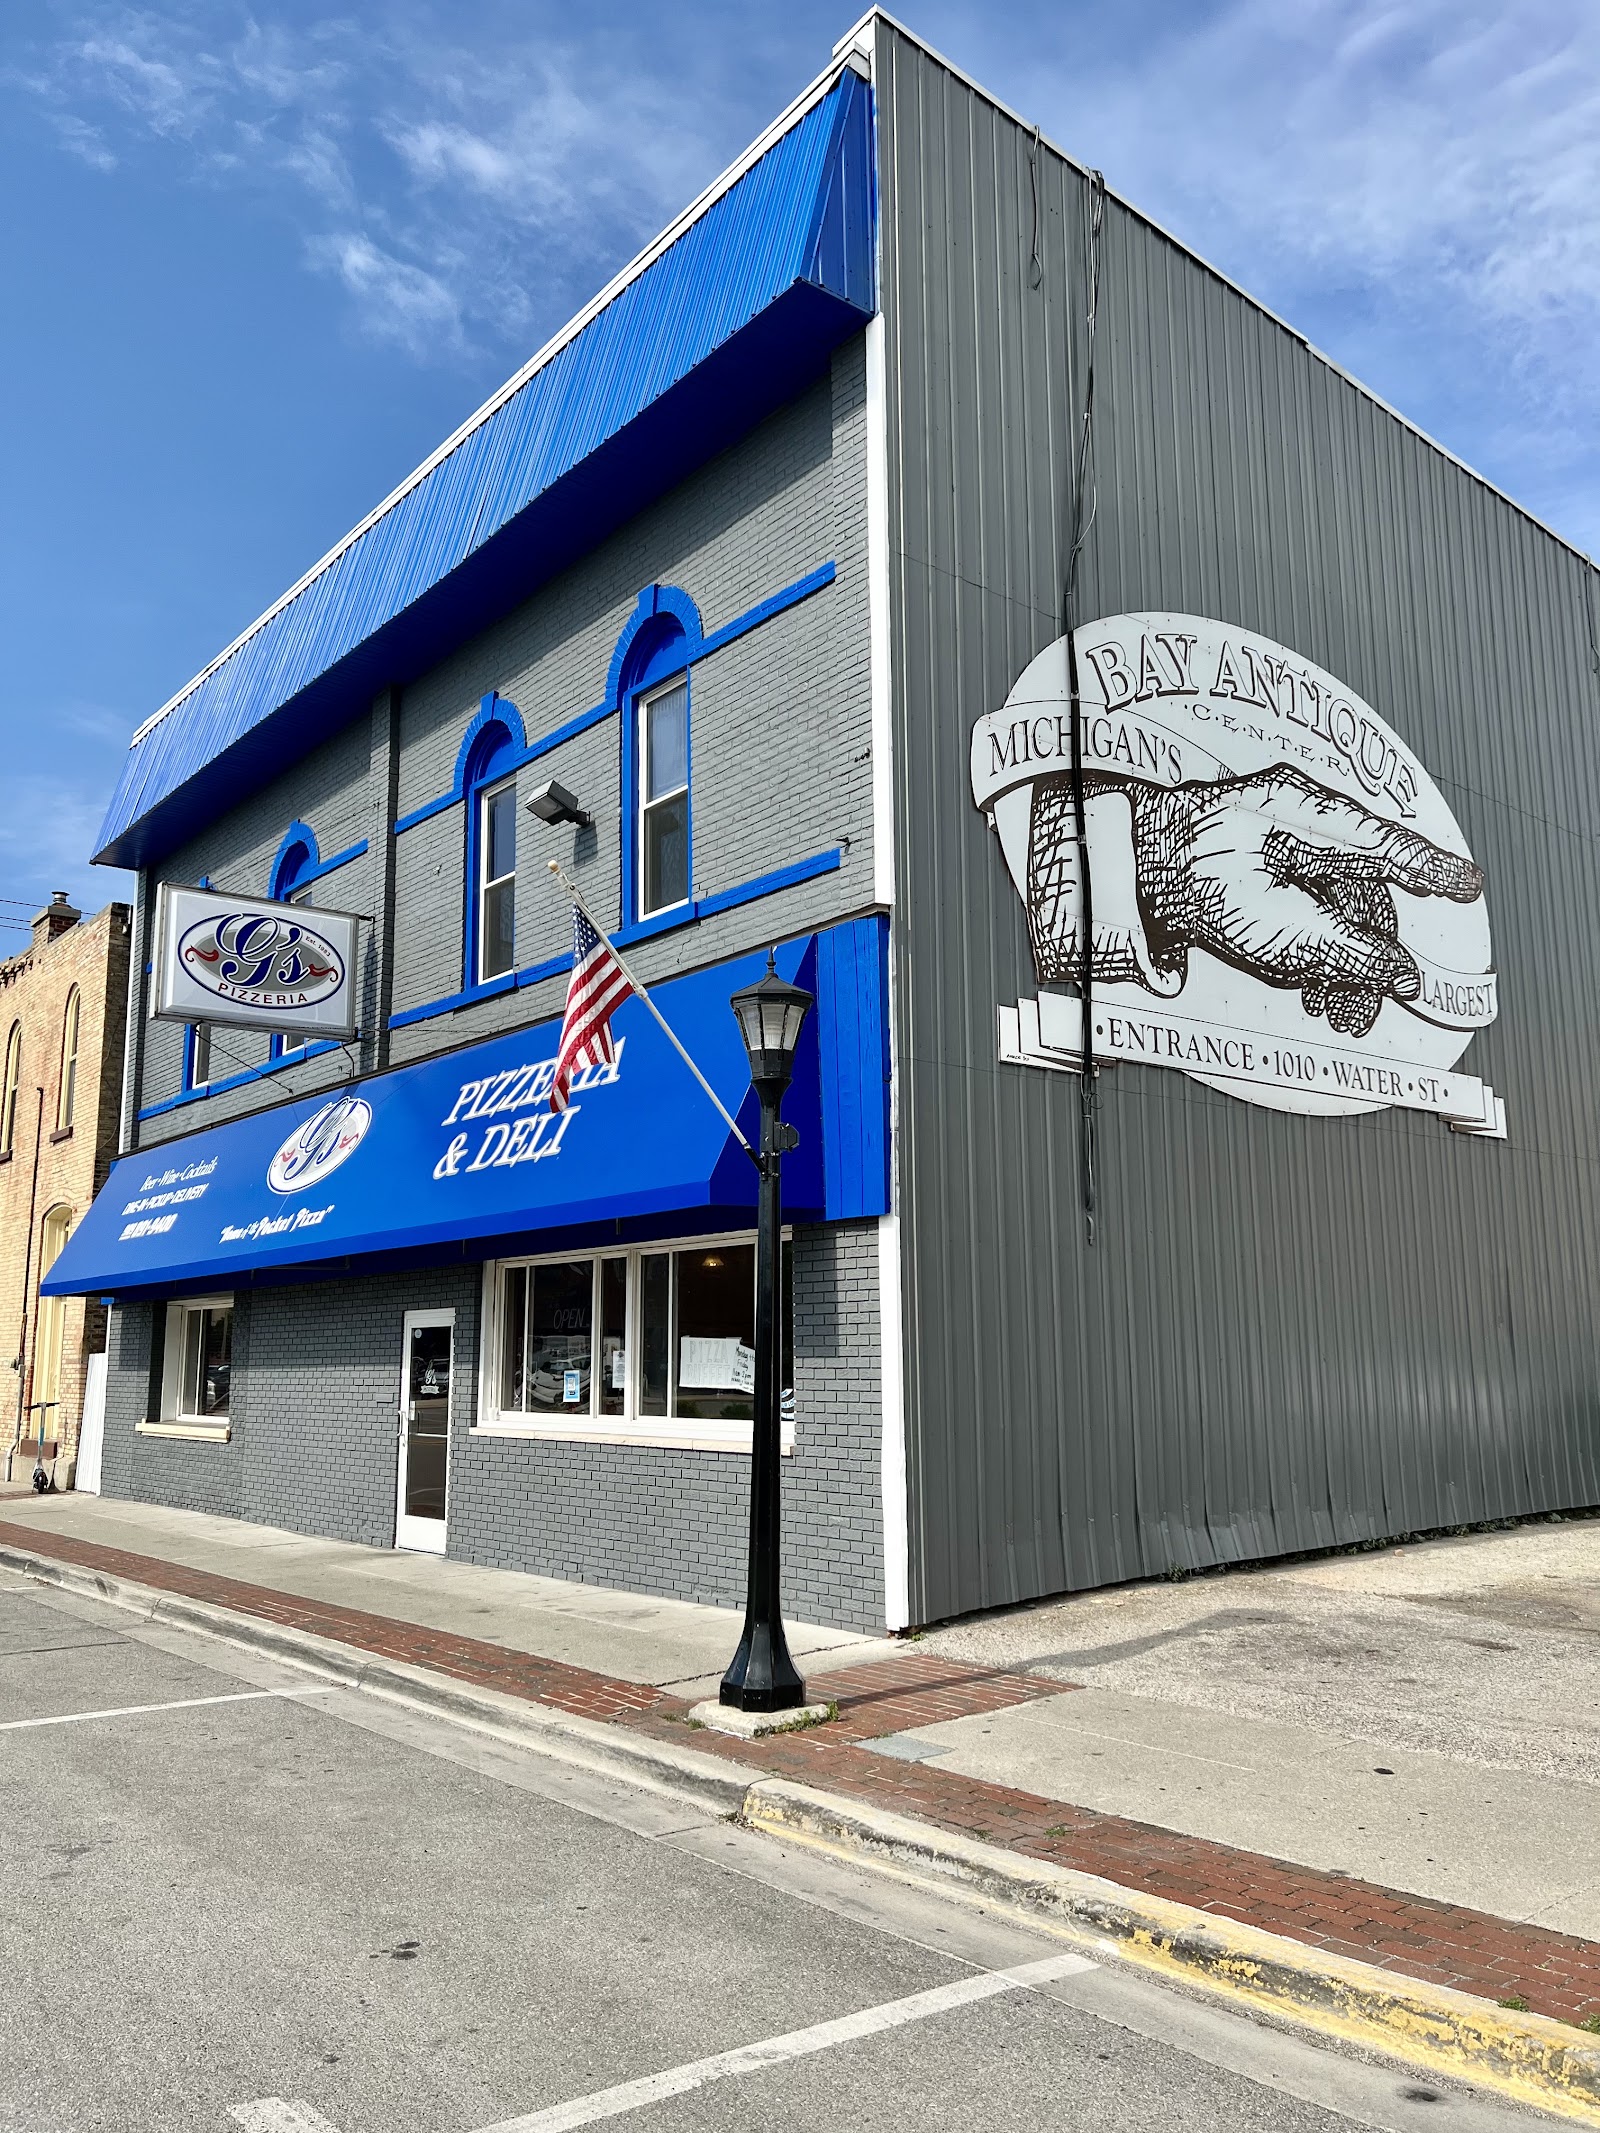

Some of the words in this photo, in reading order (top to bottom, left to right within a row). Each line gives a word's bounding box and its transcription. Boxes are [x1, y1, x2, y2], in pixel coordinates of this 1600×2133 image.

[987, 715, 1184, 785] MICHIGAN'S
[1085, 633, 1200, 715] BAY
[1209, 640, 1418, 819] ANTIQUE
[217, 982, 308, 1005] PIZZERIA
[1420, 969, 1496, 1016] LARGEST
[441, 1036, 626, 1127] PIZZEIA
[1107, 1017, 1256, 1071] ENTRANCE
[1273, 1050, 1317, 1081] 1010
[1331, 1060, 1404, 1097] WATER
[1418, 1077, 1439, 1103] ST
[433, 1132, 469, 1180] &
[465, 1105, 581, 1173] DELI
[553, 1308, 586, 1330] OPEN
[689, 1340, 728, 1363] PIZZA
